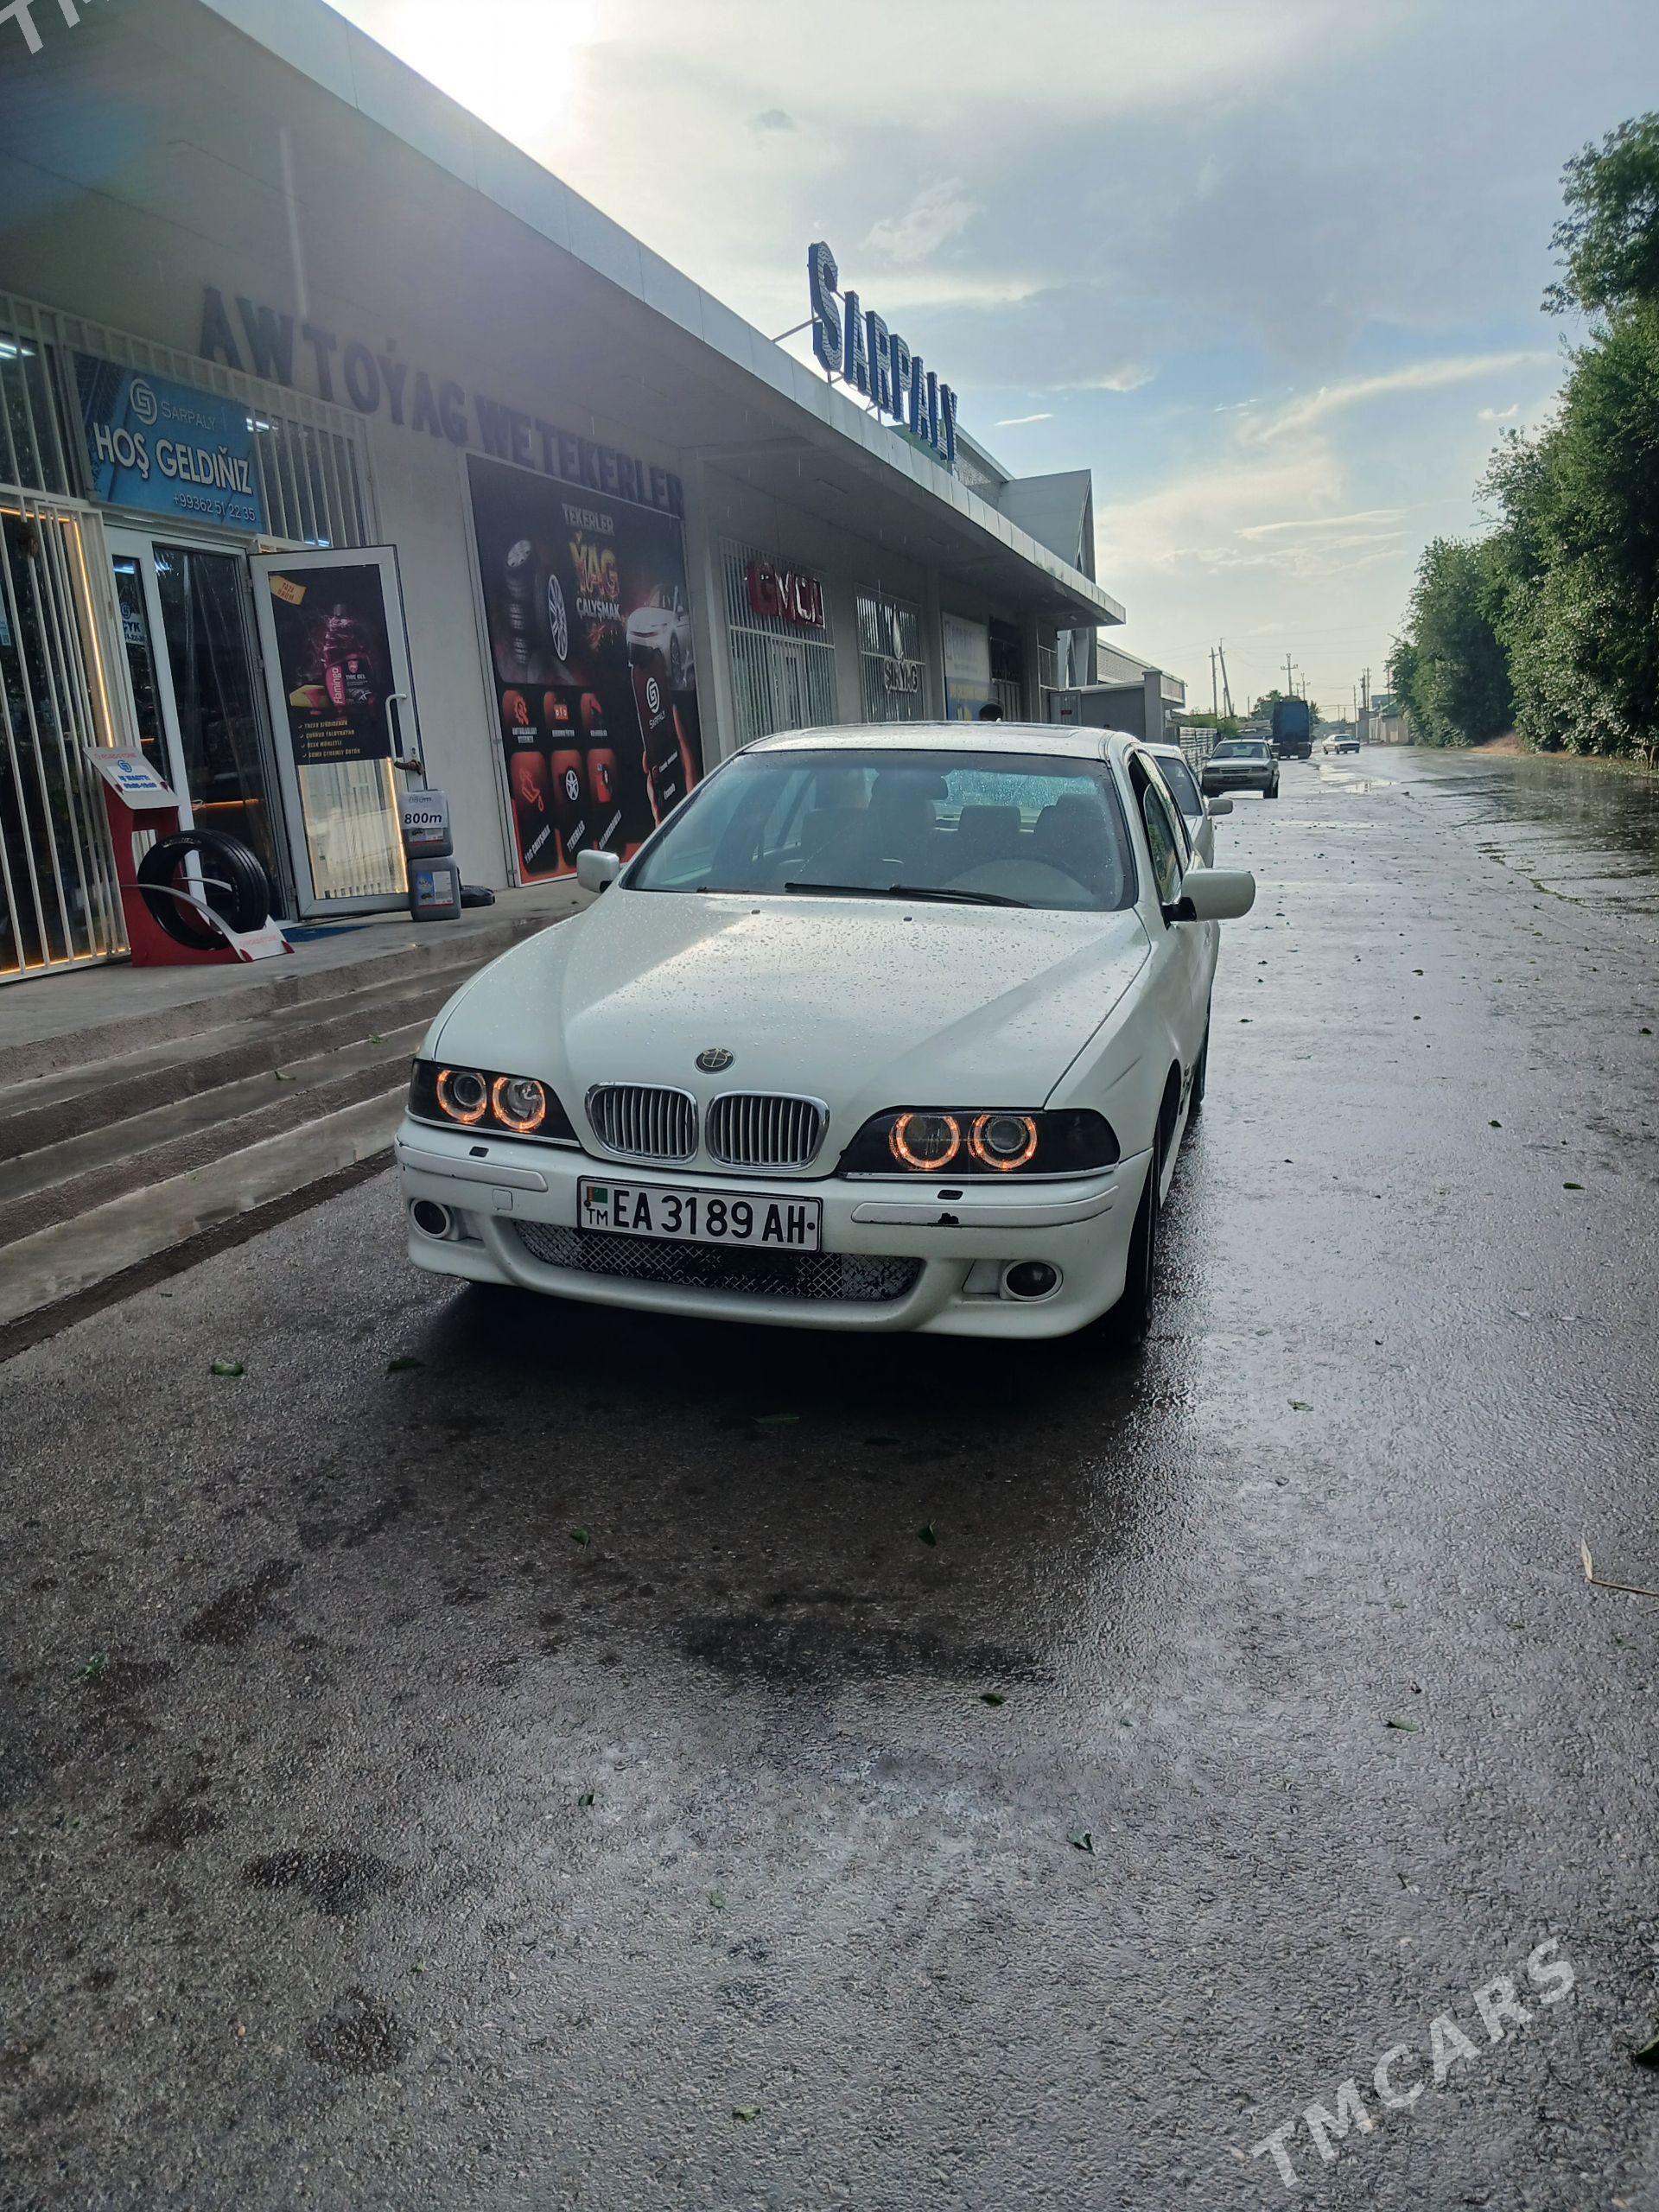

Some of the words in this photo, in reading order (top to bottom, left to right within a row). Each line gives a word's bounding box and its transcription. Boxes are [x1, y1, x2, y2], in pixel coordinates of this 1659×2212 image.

[92, 422, 150, 479] HOŞ
[156, 438, 253, 496] GELDIŇIZ
[173, 491, 213, 513] +99362
[215, 503, 226, 516] 51
[228, 503, 242, 519] 22
[243, 505, 256, 521] 35
[562, 503, 615, 536] TEKERLER
[404, 812, 442, 824] 800m
[586, 1207, 608, 1227] TM
[613, 1189, 652, 1230] EA
[661, 1194, 753, 1239] 3189
[761, 1204, 805, 1244] AH
